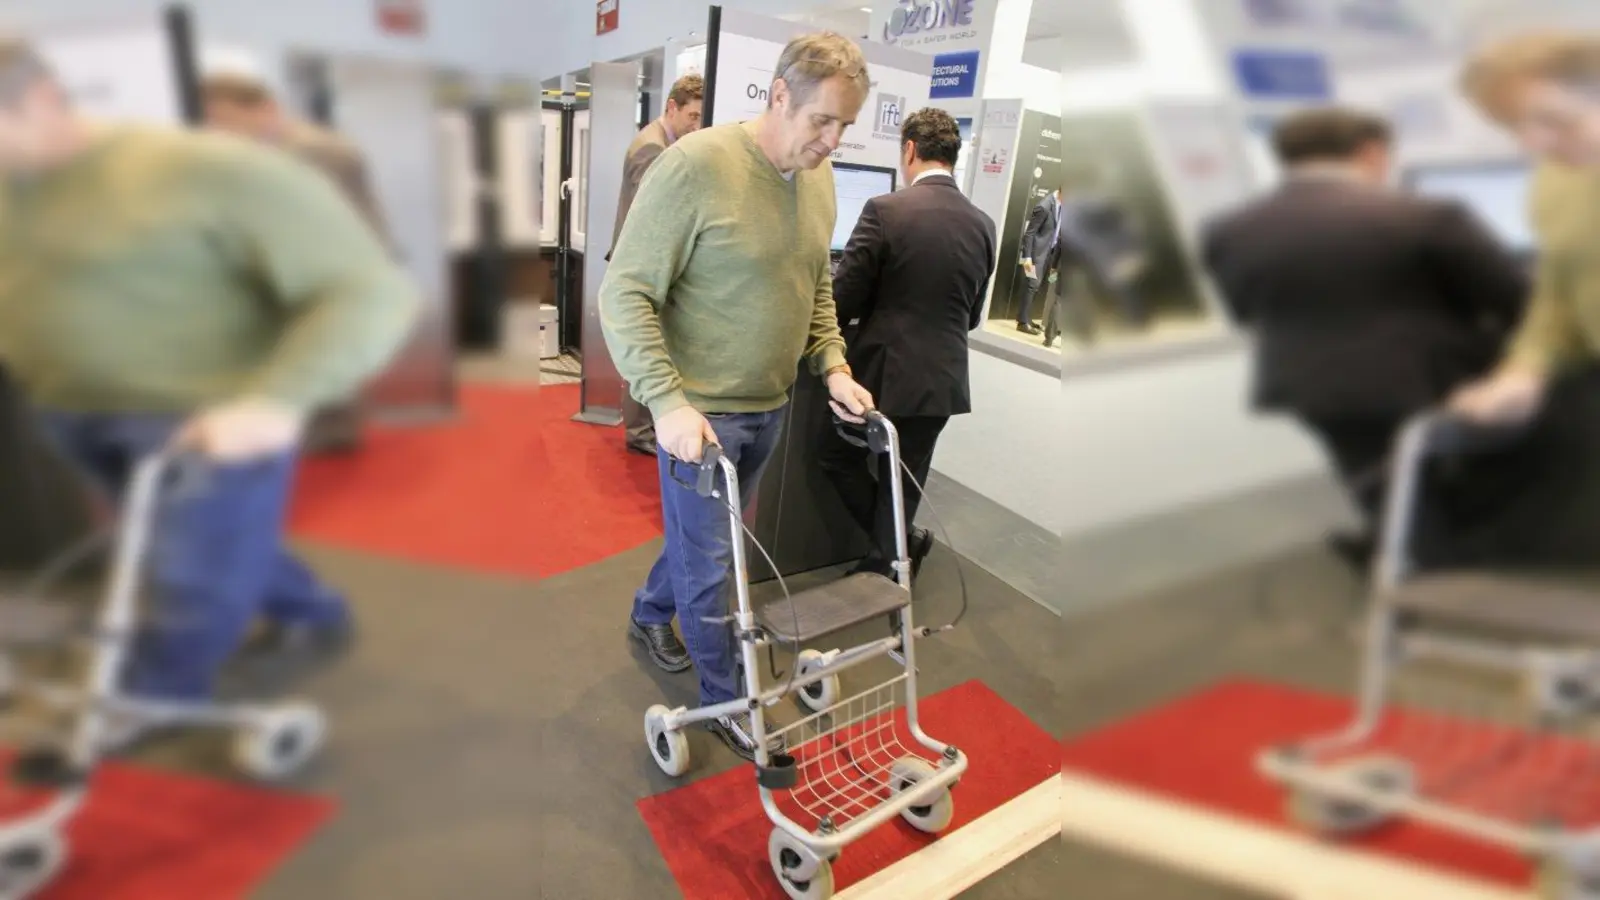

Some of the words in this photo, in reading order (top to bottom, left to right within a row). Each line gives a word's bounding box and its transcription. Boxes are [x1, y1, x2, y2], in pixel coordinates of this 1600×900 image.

[933, 64, 969, 76] TECTURAL
[747, 83, 767, 101] On
[882, 103, 901, 127] ift
[839, 141, 866, 151] enerator
